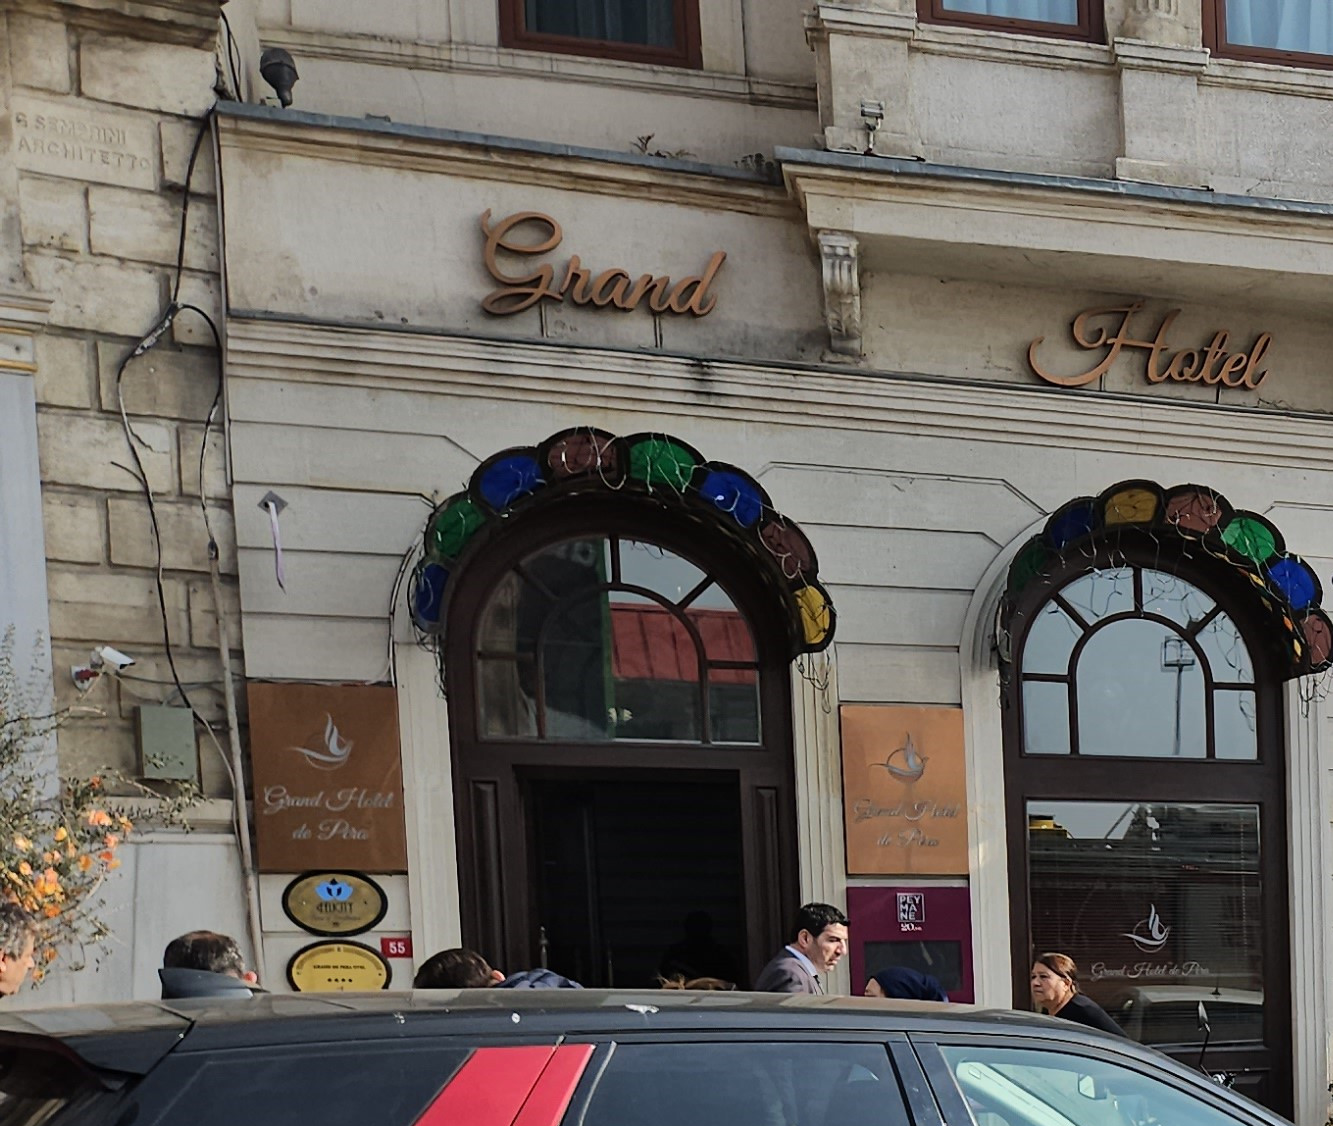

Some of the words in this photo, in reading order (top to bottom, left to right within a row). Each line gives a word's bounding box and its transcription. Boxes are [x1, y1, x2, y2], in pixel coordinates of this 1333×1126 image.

[18, 137, 150, 170] ARCHITETTO
[480, 208, 727, 316] Grand
[1029, 302, 1272, 390] Hotel
[263, 785, 324, 815] Grand
[325, 787, 394, 811] Hotel
[853, 799, 901, 823] Grand
[292, 823, 312, 840] de
[318, 818, 369, 840] Pera
[900, 895, 920, 904] PEY
[389, 941, 406, 955] 55
[1090, 961, 1126, 981] Grand
